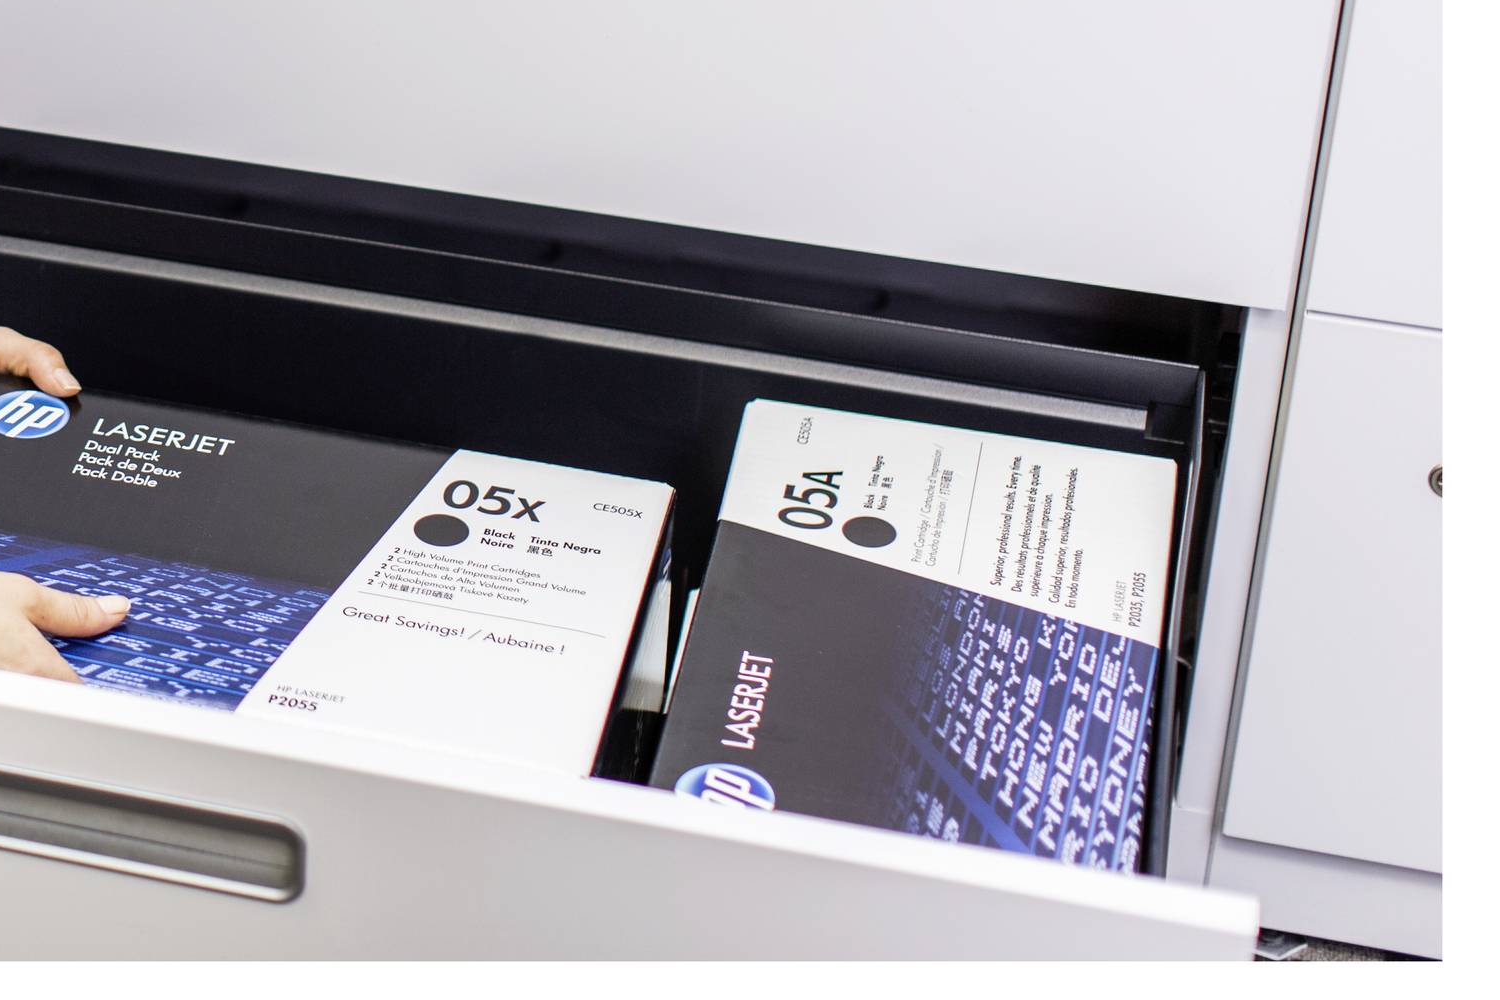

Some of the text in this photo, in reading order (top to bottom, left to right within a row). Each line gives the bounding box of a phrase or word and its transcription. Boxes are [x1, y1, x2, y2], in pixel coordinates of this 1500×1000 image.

[84, 440, 161, 462] Dual Pack
[92, 418, 236, 456] LASERJET
[72, 464, 158, 488] Pack Doble
[78, 452, 182, 479] Pack de Deux
[1009, 456, 1022, 471] time.
[1005, 471, 1022, 489] Every
[1026, 487, 1038, 496] de
[593, 502, 643, 519] CE505X
[778, 471, 844, 530] 05A
[863, 494, 875, 509] Black
[877, 495, 888, 511] Noire
[921, 484, 936, 513] Cartouche
[483, 528, 516, 540] Black
[913, 519, 931, 548] Cartridge
[931, 529, 942, 539] de
[996, 513, 1012, 554] professional
[1019, 503, 1035, 550] professionnels
[1057, 511, 1072, 545] resultados
[480, 537, 515, 550] Noire
[526, 545, 553, 557] 黑色
[530, 536, 602, 555] Tinta Negra
[911, 548, 923, 563] Print
[925, 539, 940, 567] Cartucho
[1033, 529, 1050, 554] chaque
[403, 549, 426, 559] High
[430, 553, 465, 565] Volume
[467, 560, 488, 569] Print
[491, 564, 541, 578] Cartridges
[990, 555, 1008, 586] Superior,
[1054, 546, 1068, 575] superior,
[390, 565, 437, 579] Cartuchos
[456, 577, 476, 585] Alto
[480, 580, 520, 593] Volumen
[397, 557, 449, 571] Cartouches
[516, 577, 548, 589] Grand
[551, 583, 587, 595] Volume
[1010, 580, 1023, 592] Des
[1048, 575, 1063, 604] Calidad
[49, 569, 290, 624] PARIS
[497, 592, 529, 605] Kazety
[1064, 599, 1077, 609] En
[1066, 582, 1079, 599] todo
[1112, 580, 1127, 623] HP LASERJET
[1128, 571, 1147, 628] P2035, P2055
[342, 605, 391, 624] Great
[395, 615, 465, 638] Savings!
[483, 631, 555, 654] Aubaine
[276, 684, 347, 704] HP LASERJET
[720, 650, 774, 750] LASERJET
[949, 618, 996, 755] MIAMI
[964, 624, 1013, 771] PARIS
[268, 694, 318, 712] P2055
[980, 636, 1030, 781] TOKYO
[998, 674, 1043, 808] HONG
[1038, 642, 1098, 852] MADRID
[1016, 719, 1053, 829] NEW
